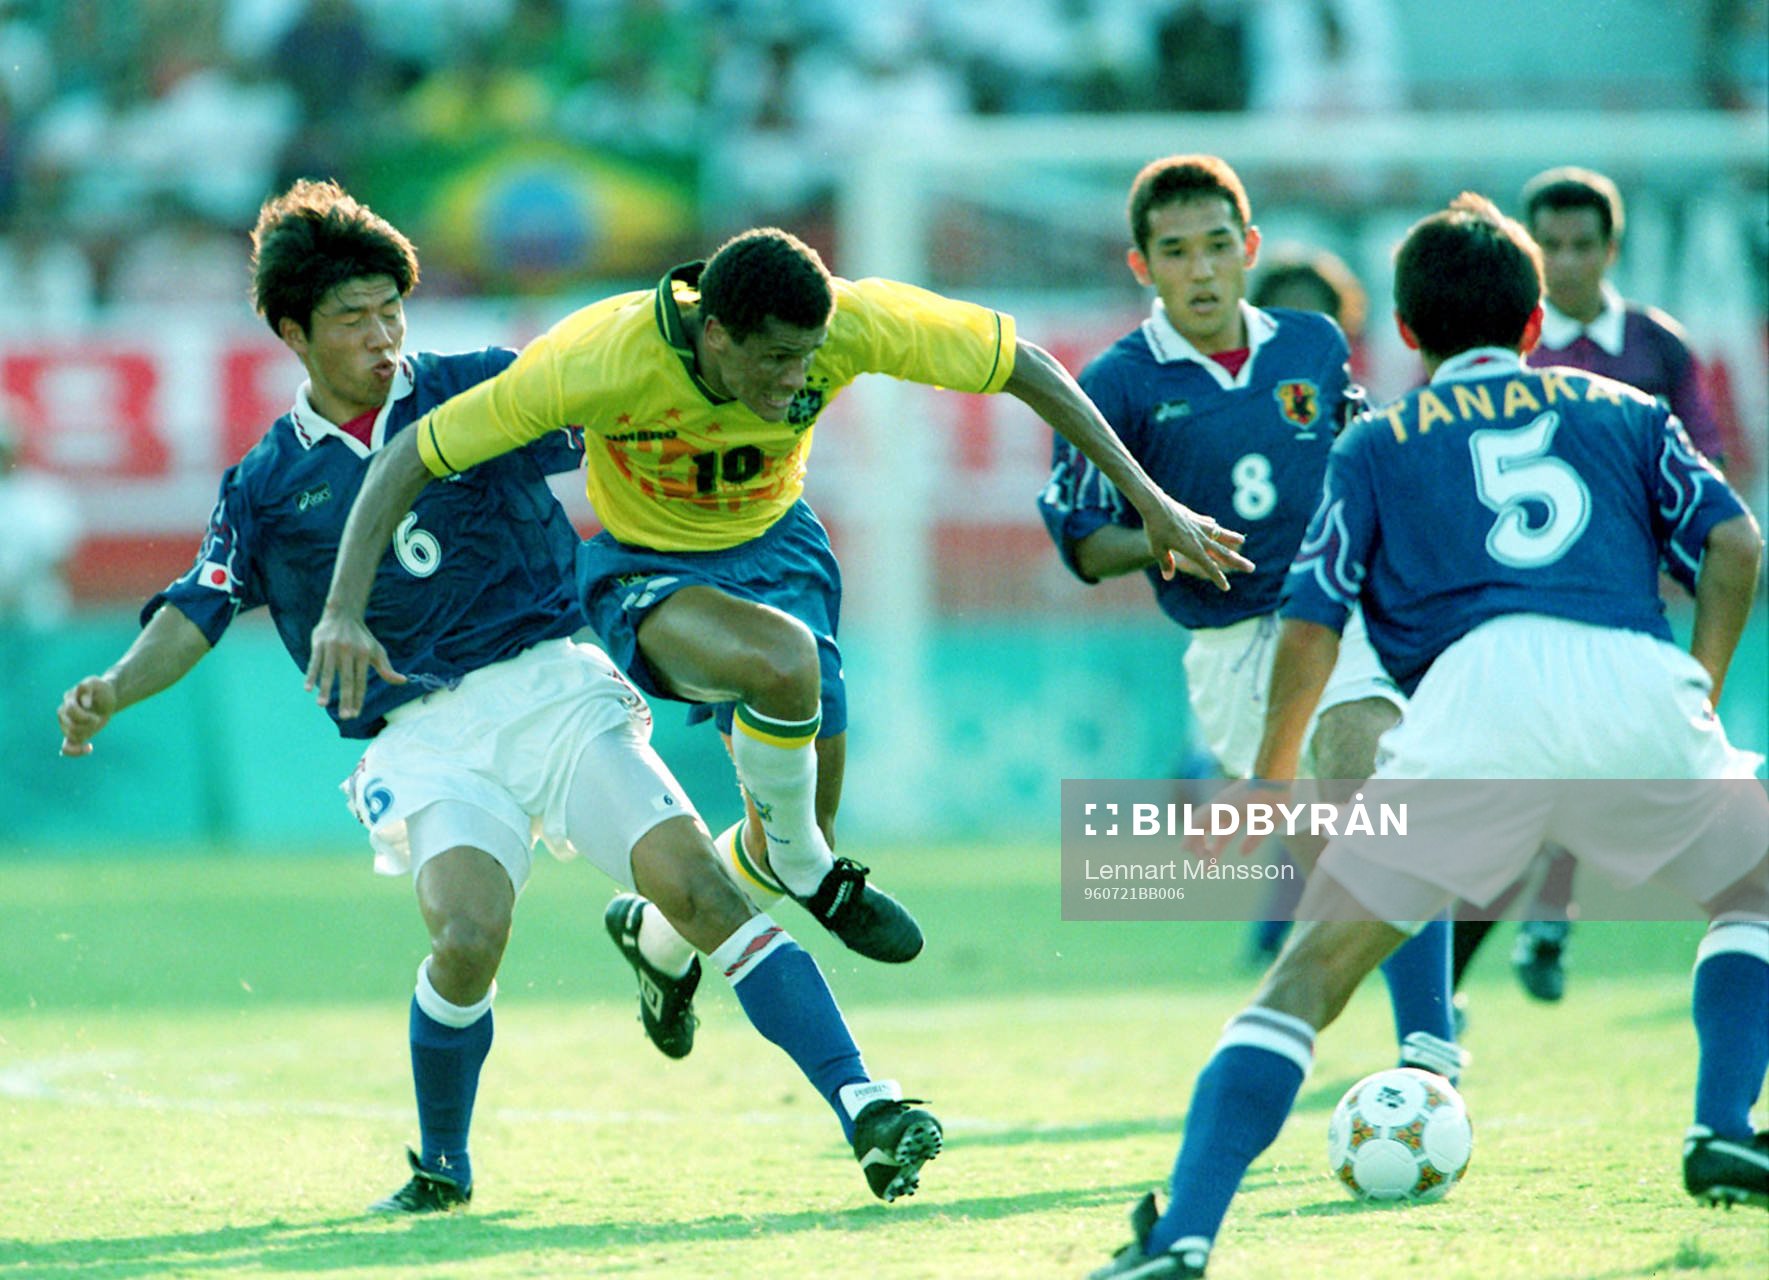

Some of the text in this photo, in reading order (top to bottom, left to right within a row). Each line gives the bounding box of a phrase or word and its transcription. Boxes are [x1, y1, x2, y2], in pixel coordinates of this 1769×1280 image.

[692, 444, 764, 493] 10
[1231, 453, 1278, 521] 8
[1468, 410, 1592, 569] 5
[393, 511, 441, 578] 6
[663, 794, 674, 806] 6
